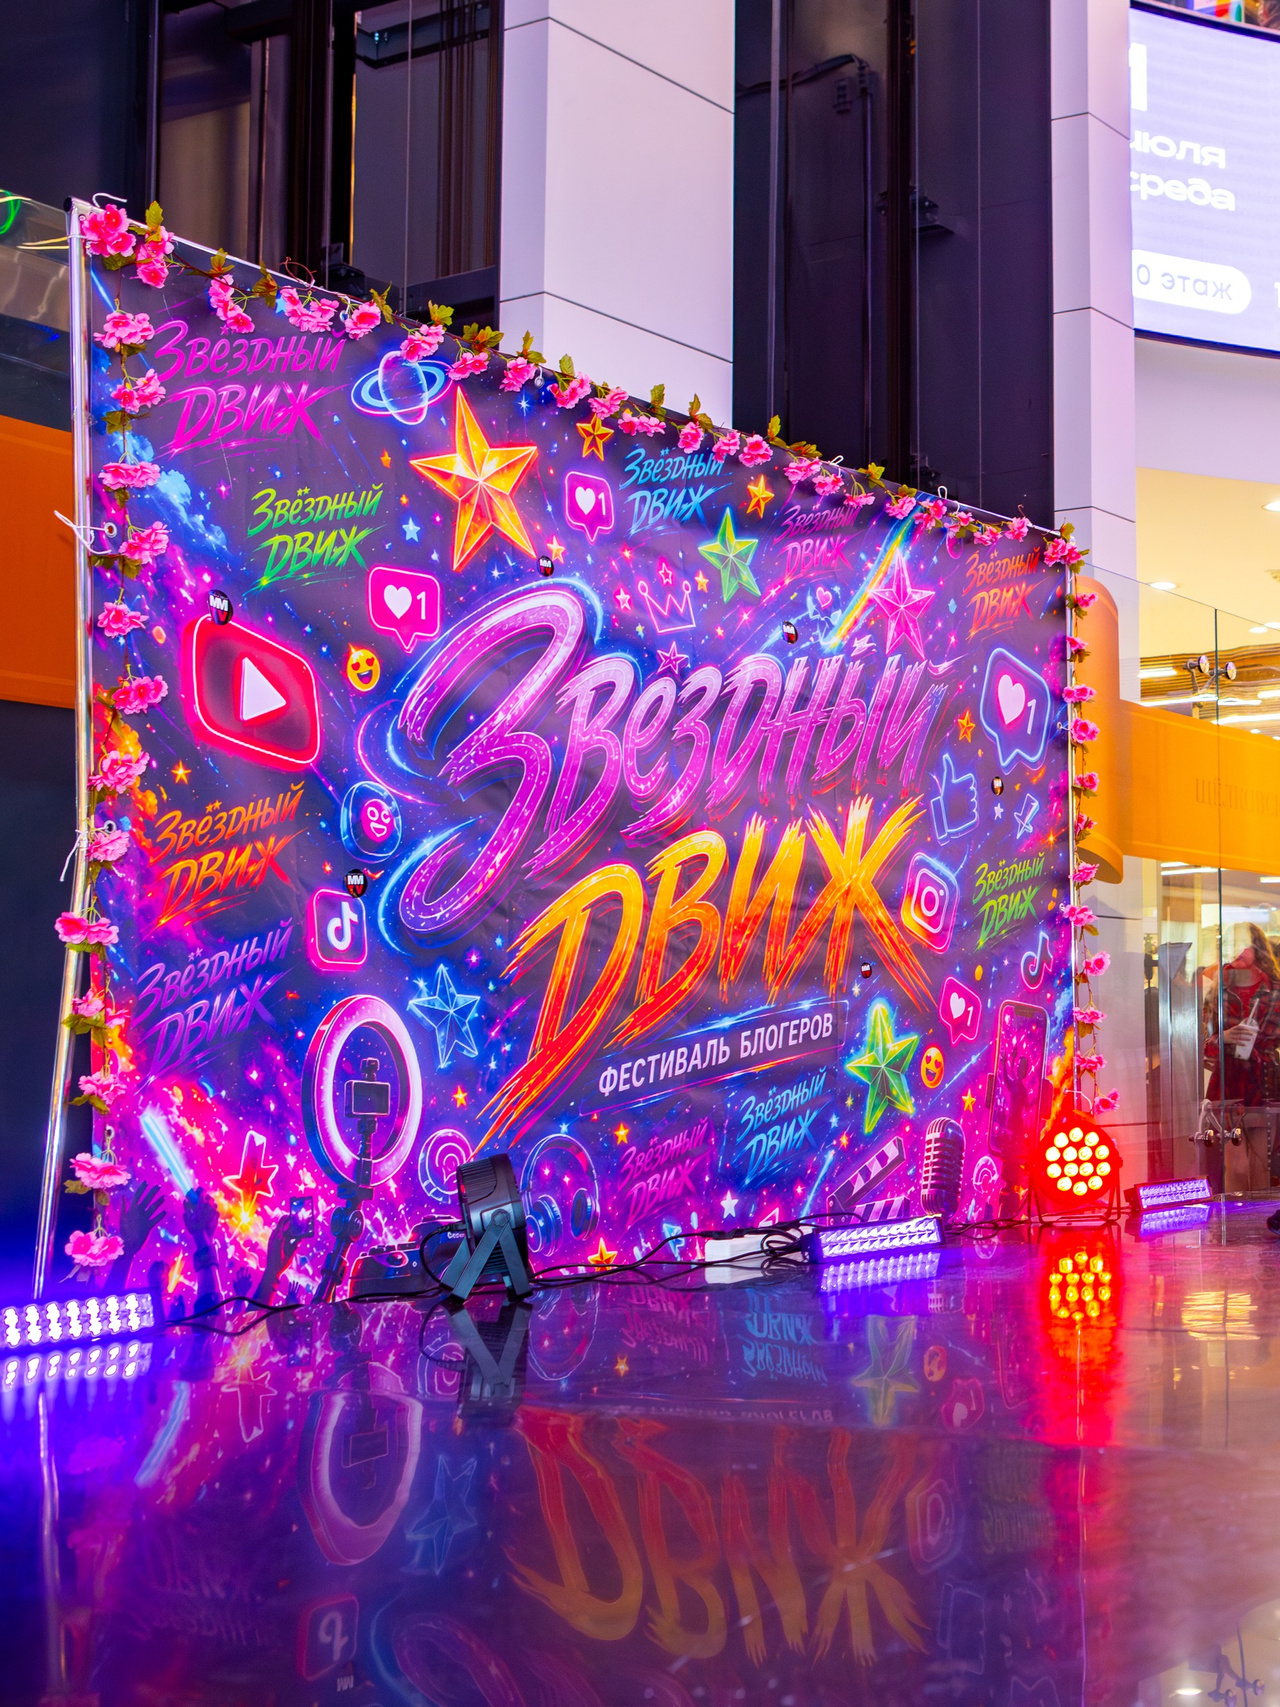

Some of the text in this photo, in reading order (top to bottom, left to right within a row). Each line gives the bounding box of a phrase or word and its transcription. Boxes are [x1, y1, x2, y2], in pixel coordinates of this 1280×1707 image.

[1160, 269, 1232, 301] этаж
[416, 591, 426, 620] 1
[599, 1012, 834, 1097] ФЕСТИВАЛЬ БЛОГЕРОВ
